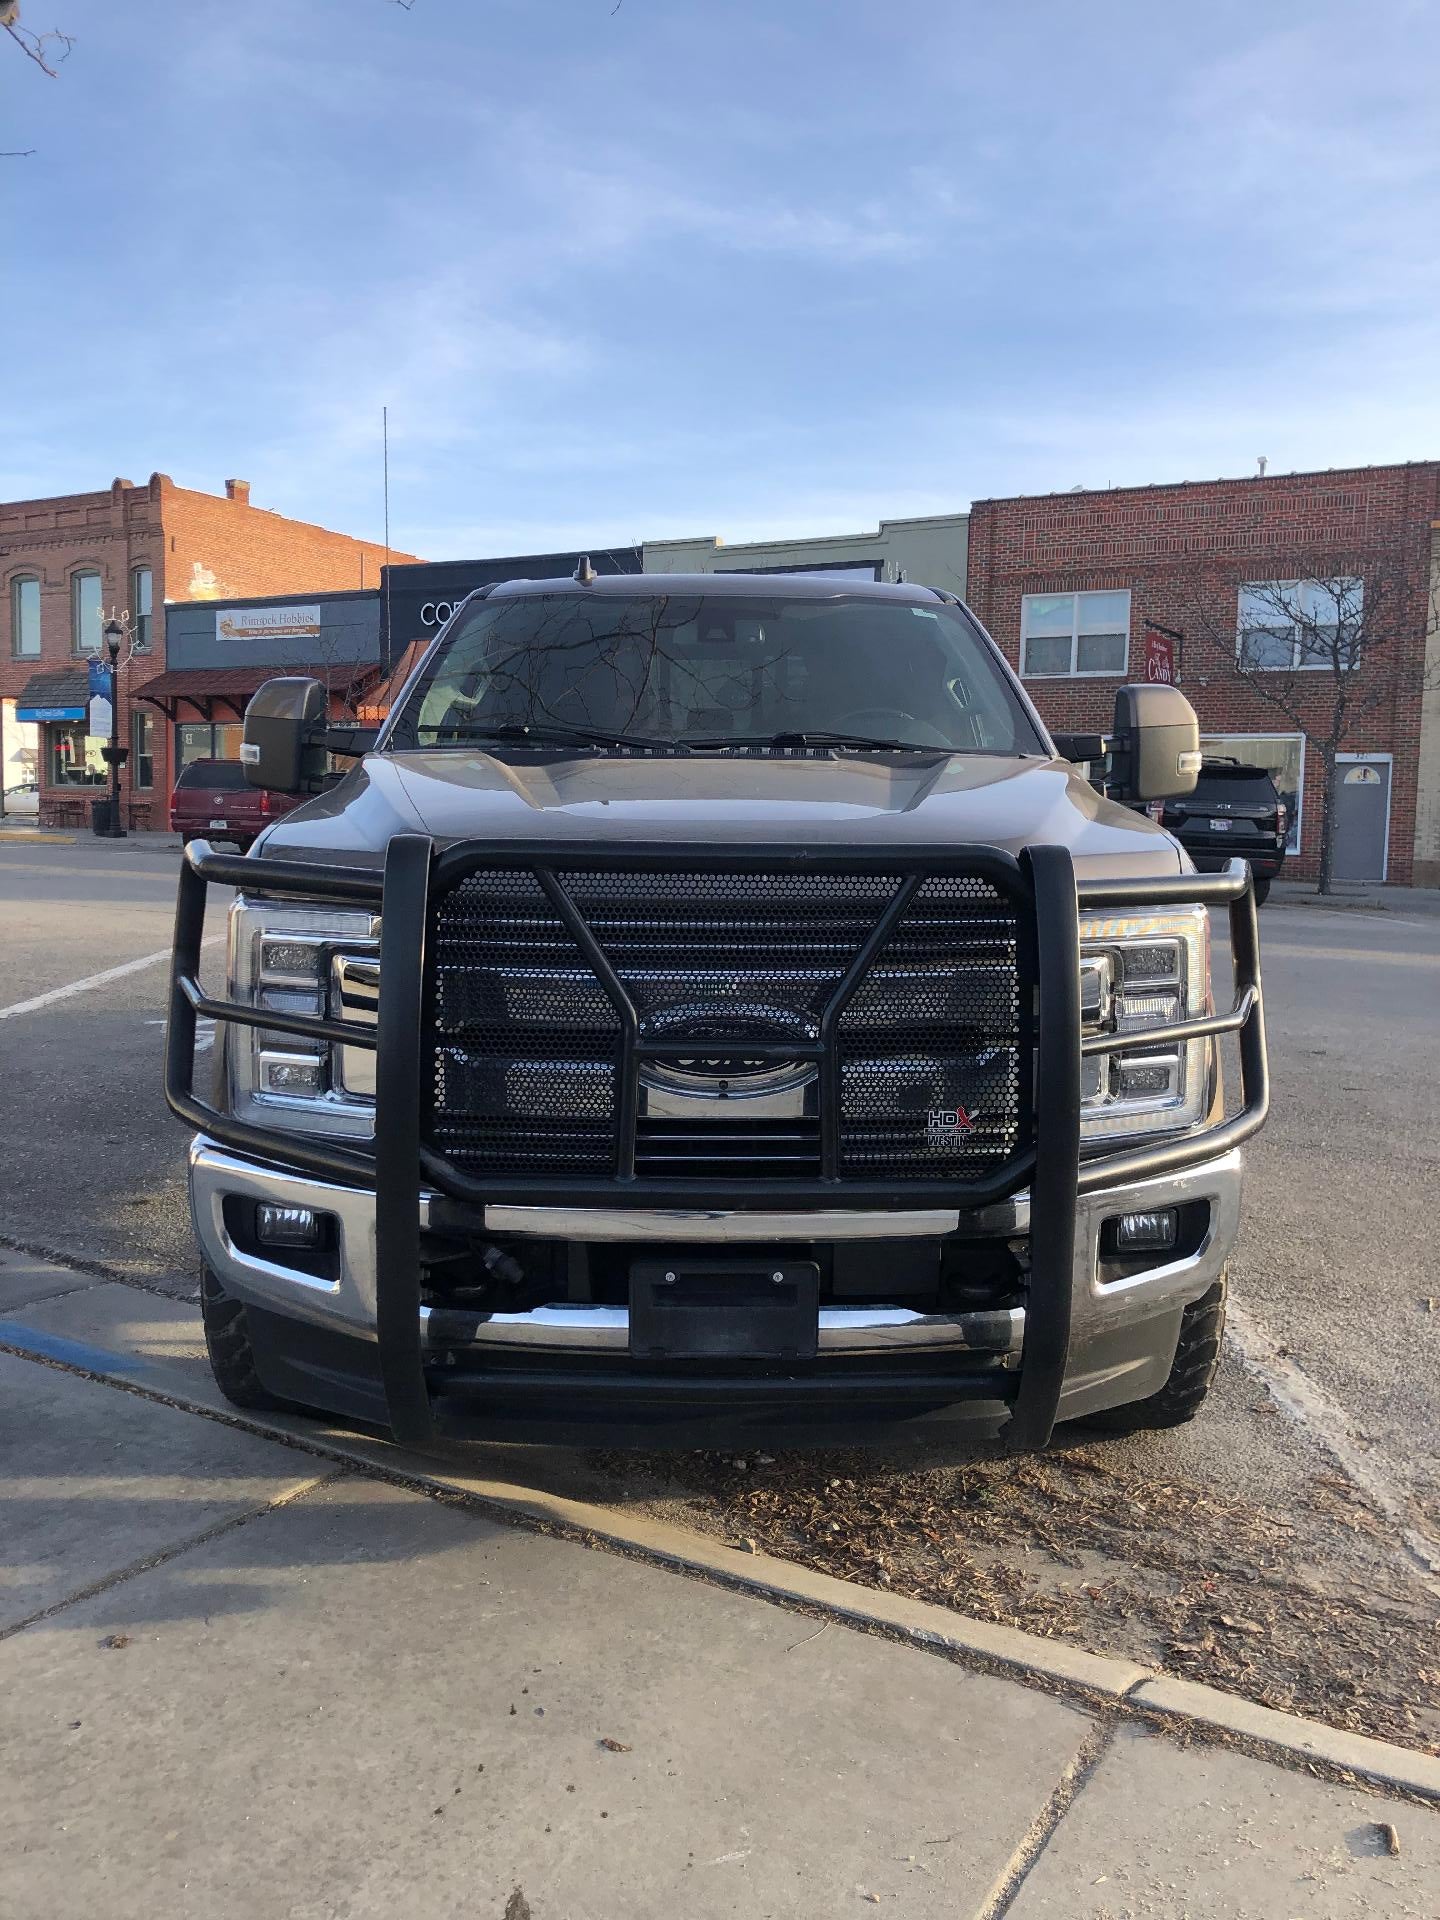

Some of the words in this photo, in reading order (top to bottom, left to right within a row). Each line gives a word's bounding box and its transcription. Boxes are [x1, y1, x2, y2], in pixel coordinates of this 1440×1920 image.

[241, 615, 277, 626] Rimrock
[280, 612, 314, 624] Hobbies
[928, 1105, 979, 1129] HDX
